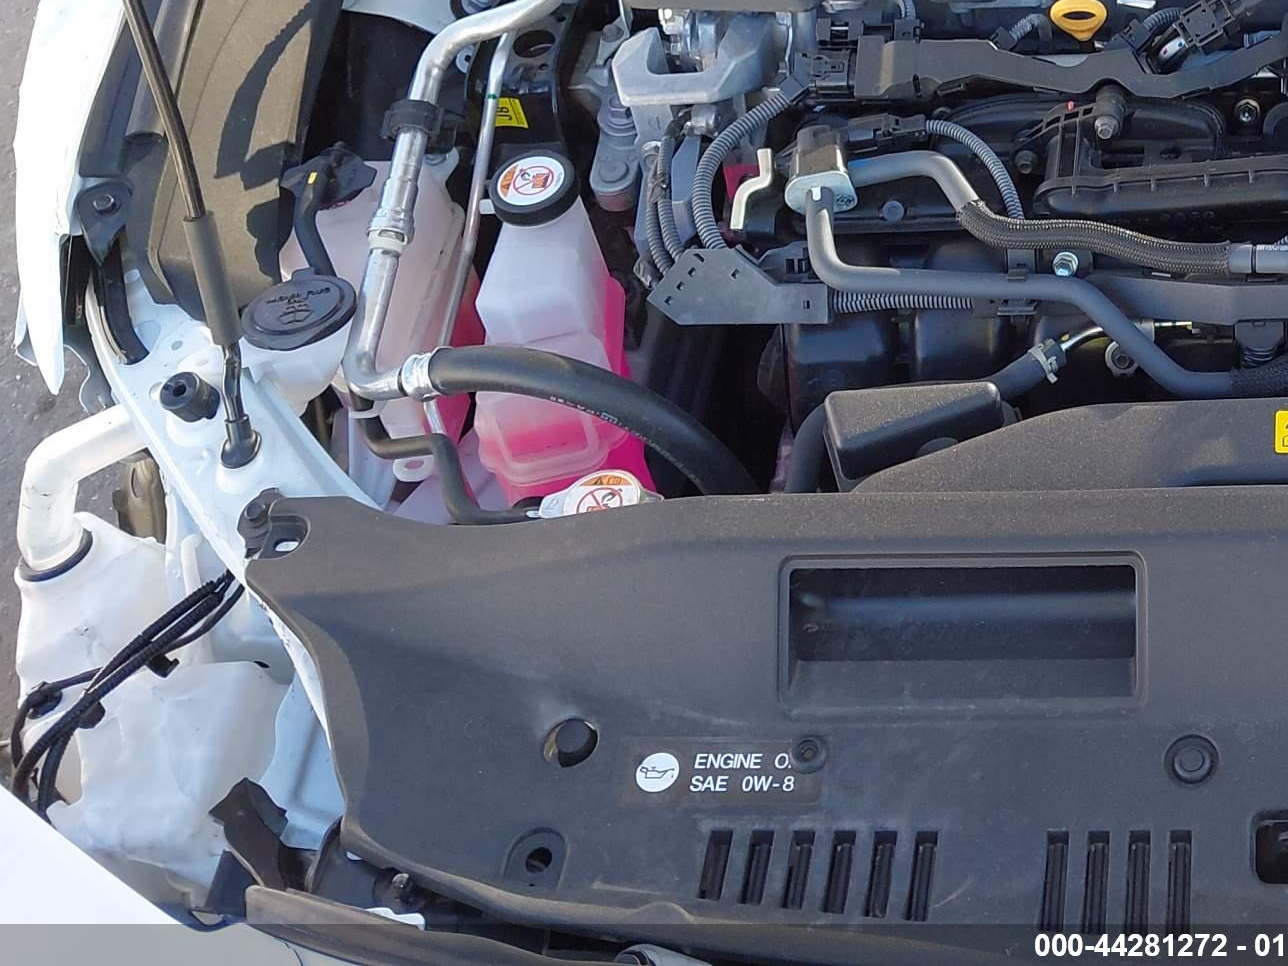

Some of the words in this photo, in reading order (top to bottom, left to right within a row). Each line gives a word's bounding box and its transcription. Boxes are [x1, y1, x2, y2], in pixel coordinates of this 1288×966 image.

[694, 753, 763, 769] ENGINE
[689, 775, 729, 792] SAE
[741, 775, 795, 792] 0W-8
